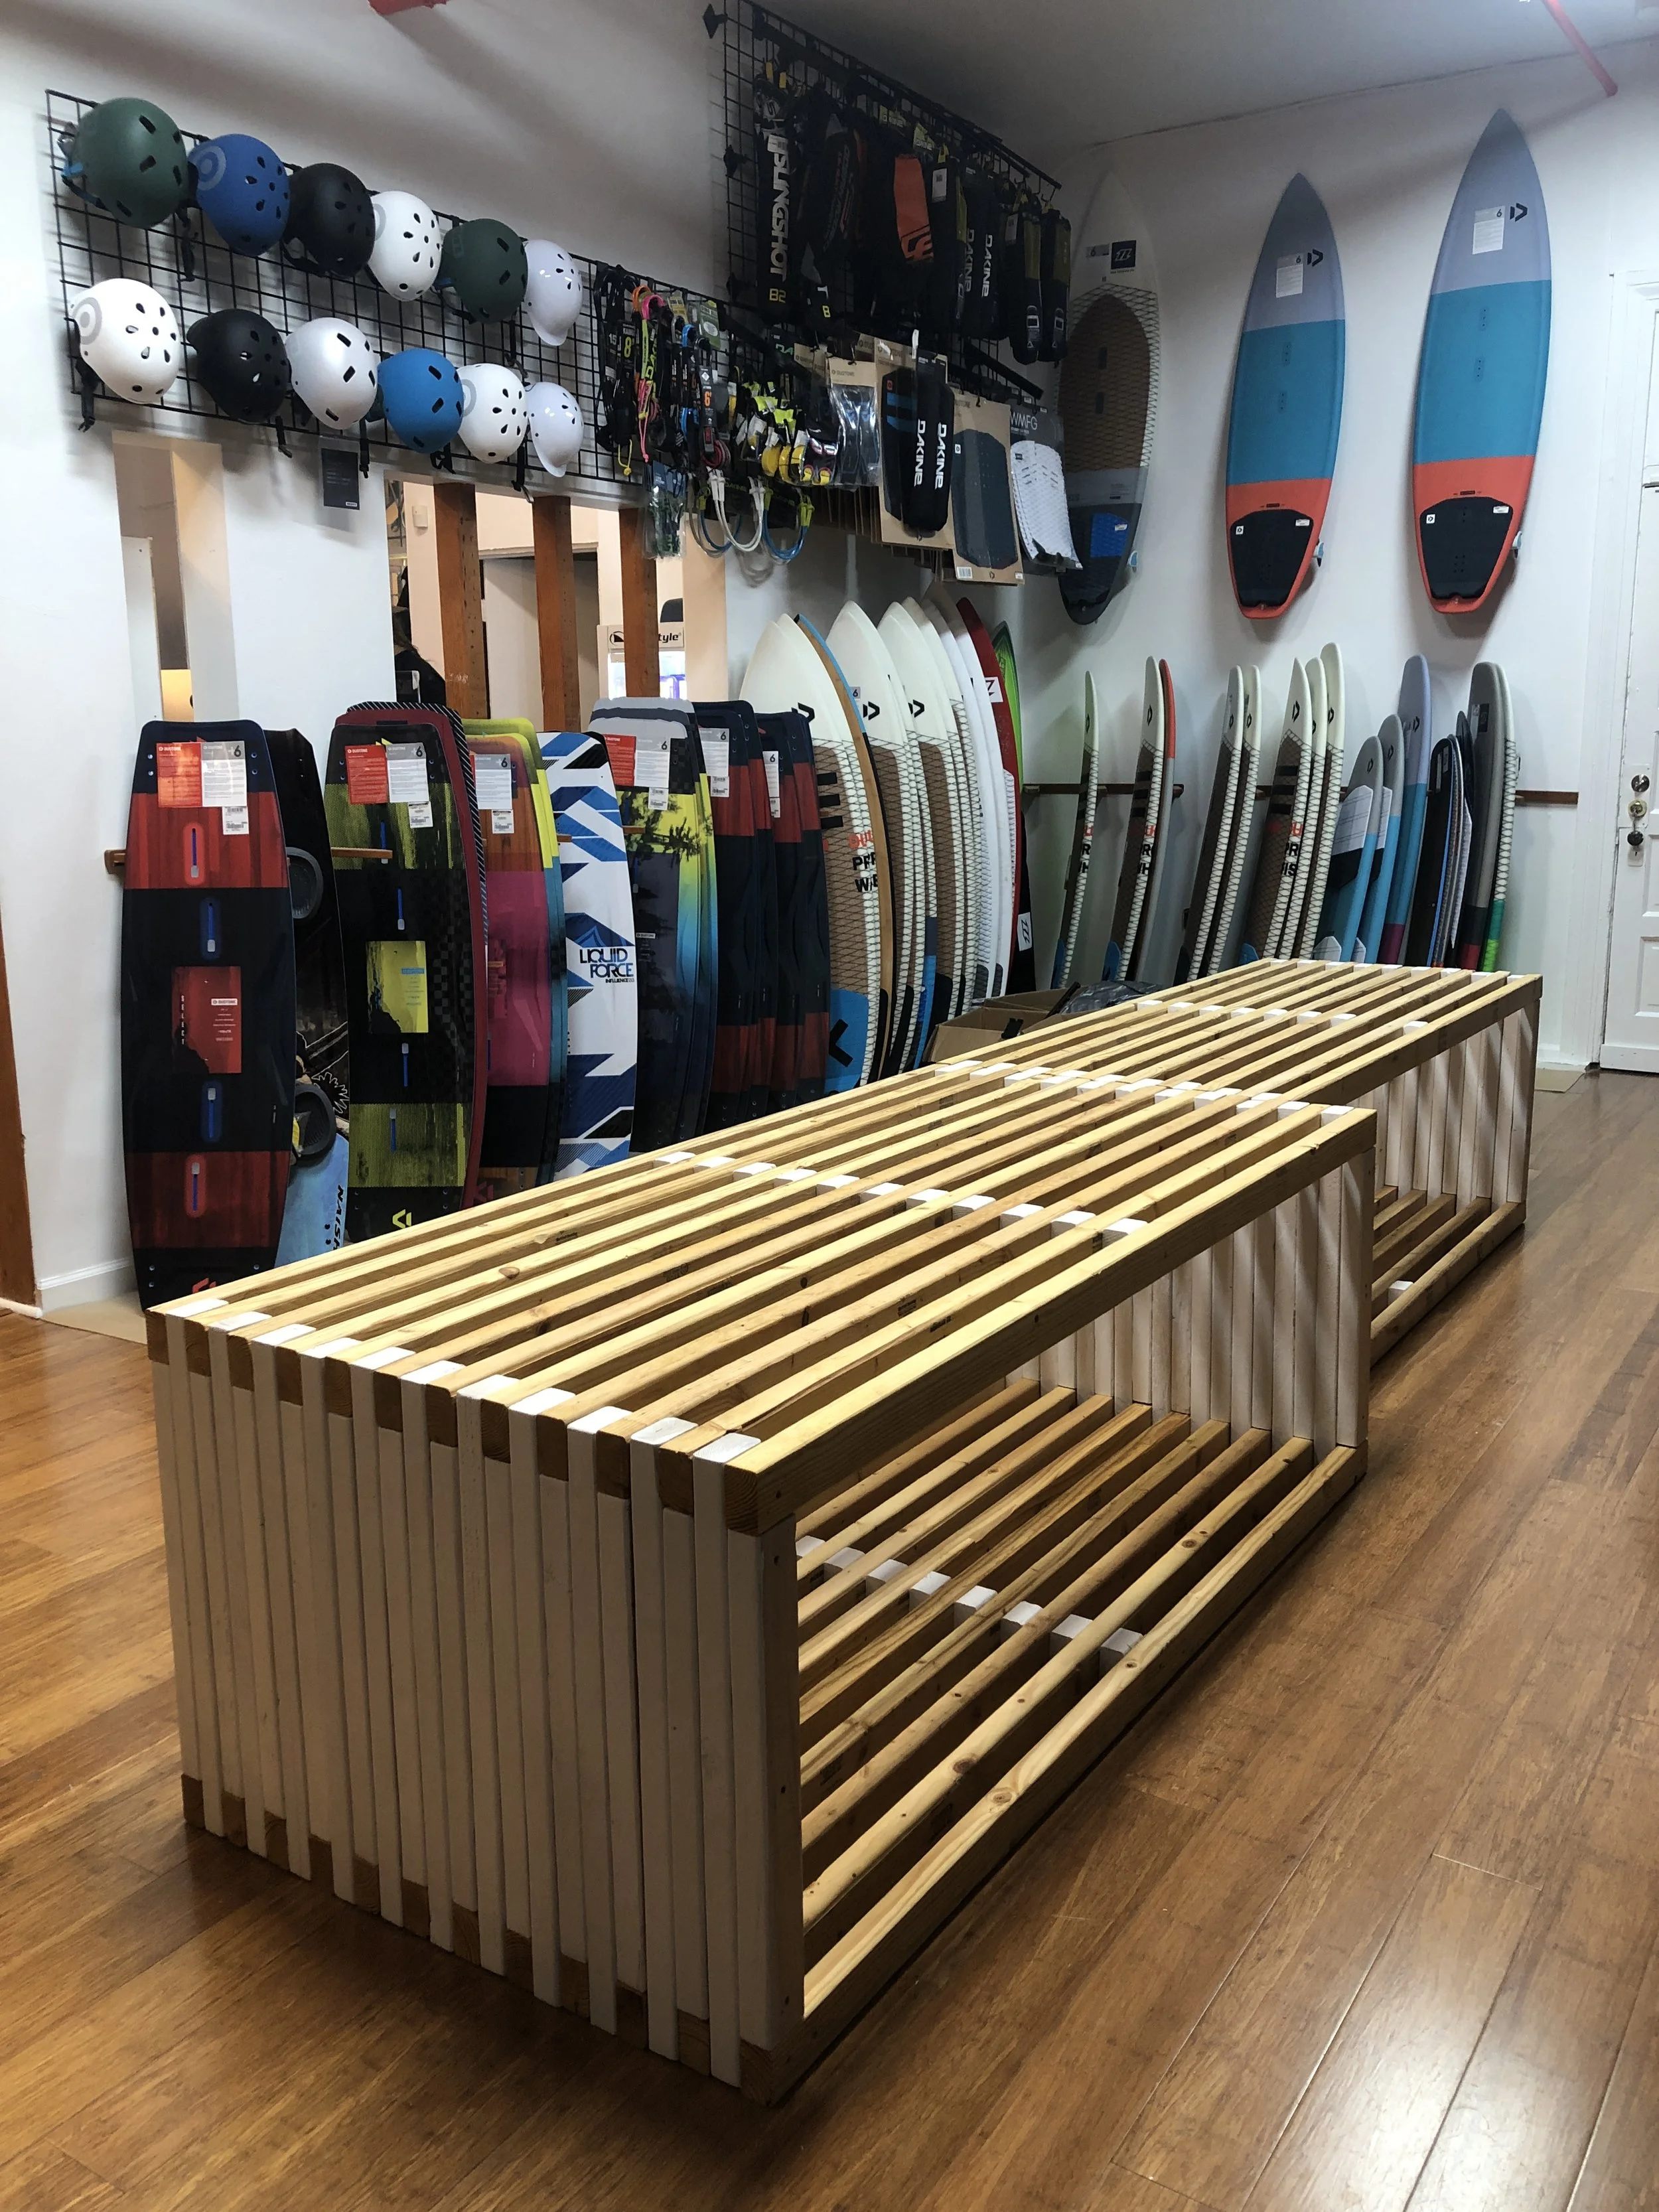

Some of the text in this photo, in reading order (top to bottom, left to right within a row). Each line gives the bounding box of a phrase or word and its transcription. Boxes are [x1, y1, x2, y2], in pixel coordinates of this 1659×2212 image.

[981, 233, 993, 297] DAKINE
[914, 418, 926, 487] DAKINE
[934, 422, 948, 490] DAKINE
[658, 632, 679, 643] tyle
[853, 688, 859, 698] 6
[579, 948, 628, 964] LIQUID
[590, 963, 634, 978] FORCE
